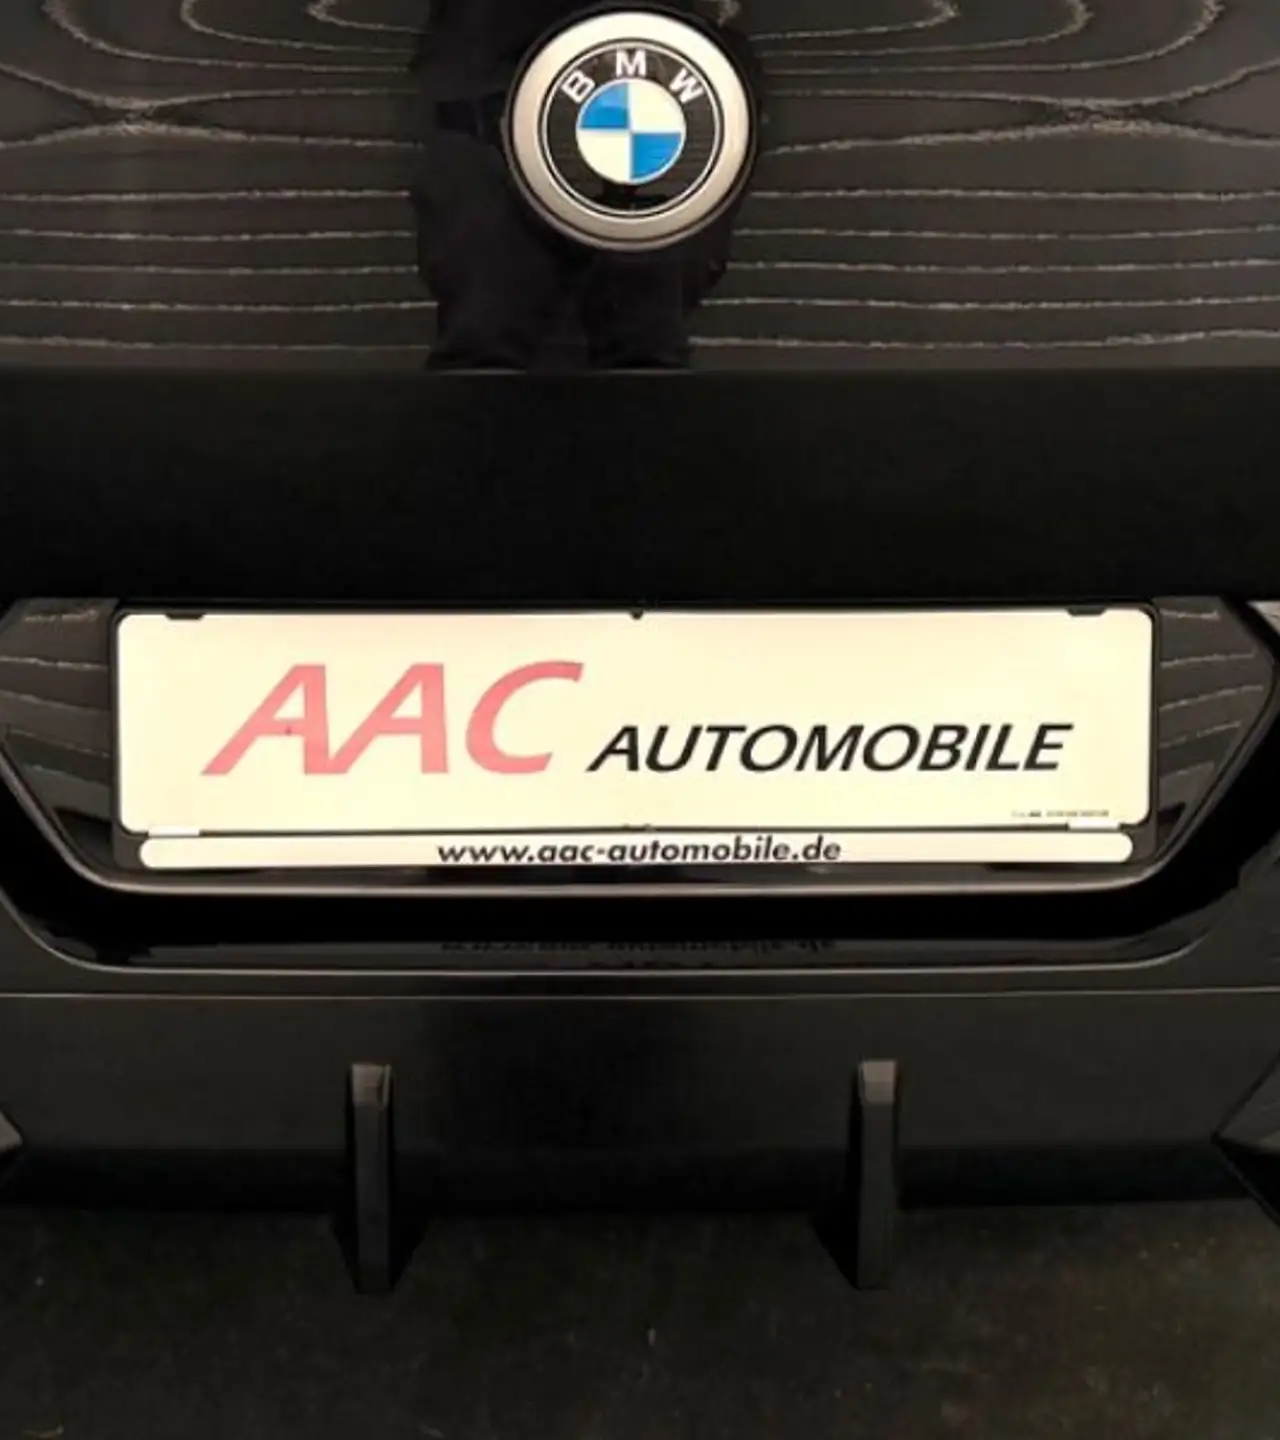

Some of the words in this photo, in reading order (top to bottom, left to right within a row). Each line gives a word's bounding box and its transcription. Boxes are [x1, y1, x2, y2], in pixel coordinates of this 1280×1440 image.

[561, 49, 705, 105] BMW
[203, 659, 584, 776] AAC
[586, 723, 1074, 773] AUTOMOBILE
[437, 835, 842, 863] www.aac-automobile.de
